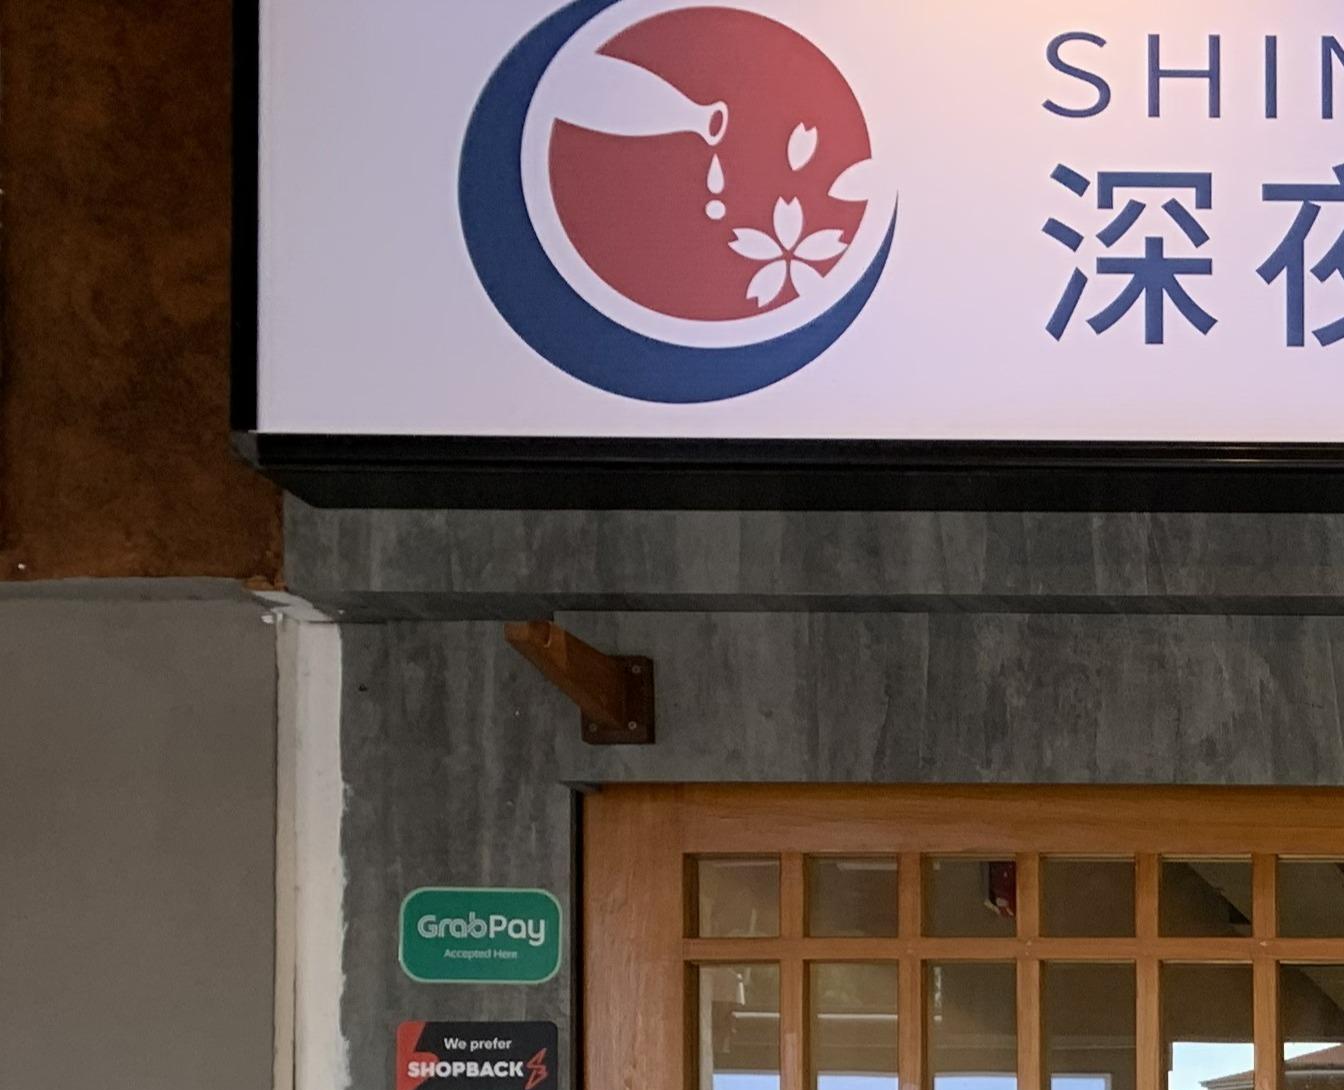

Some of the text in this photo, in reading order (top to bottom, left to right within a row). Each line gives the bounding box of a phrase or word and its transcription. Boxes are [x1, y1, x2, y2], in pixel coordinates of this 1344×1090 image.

[417, 911, 545, 946] GrabPay
[443, 949, 517, 960] Accepted Here
[444, 1037, 512, 1052] We prefer
[408, 1061, 524, 1077] SHOPBACK
